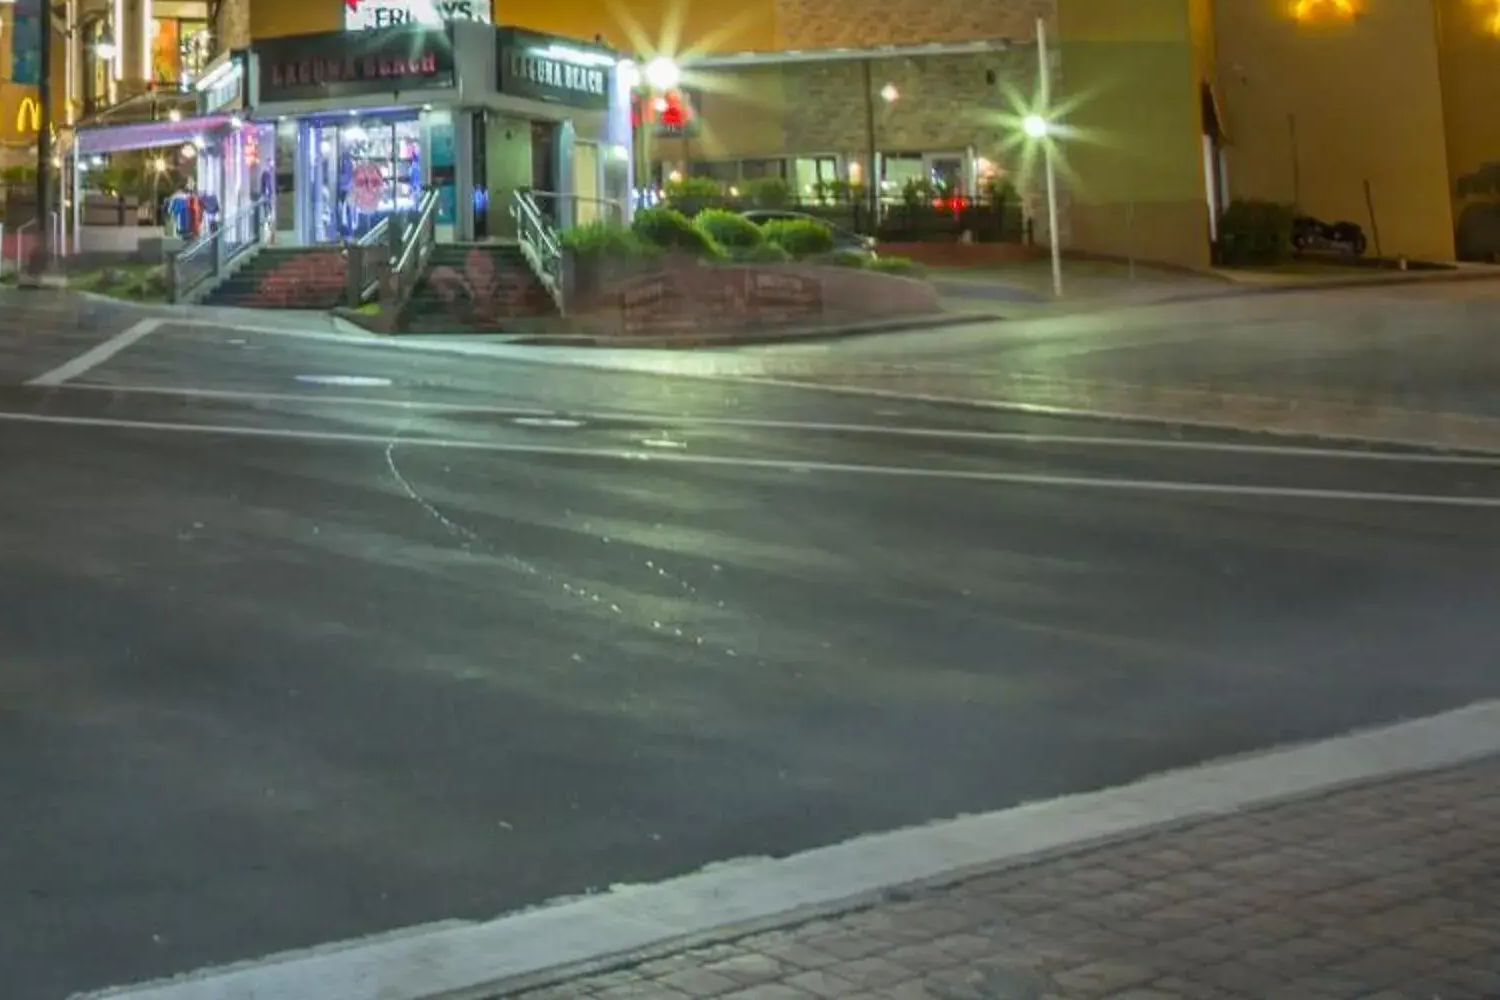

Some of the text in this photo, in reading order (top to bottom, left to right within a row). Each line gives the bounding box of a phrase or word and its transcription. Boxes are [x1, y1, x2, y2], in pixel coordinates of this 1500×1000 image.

[272, 54, 357, 86] LAGUNA
[510, 53, 604, 95] LAGUNA BEACH
